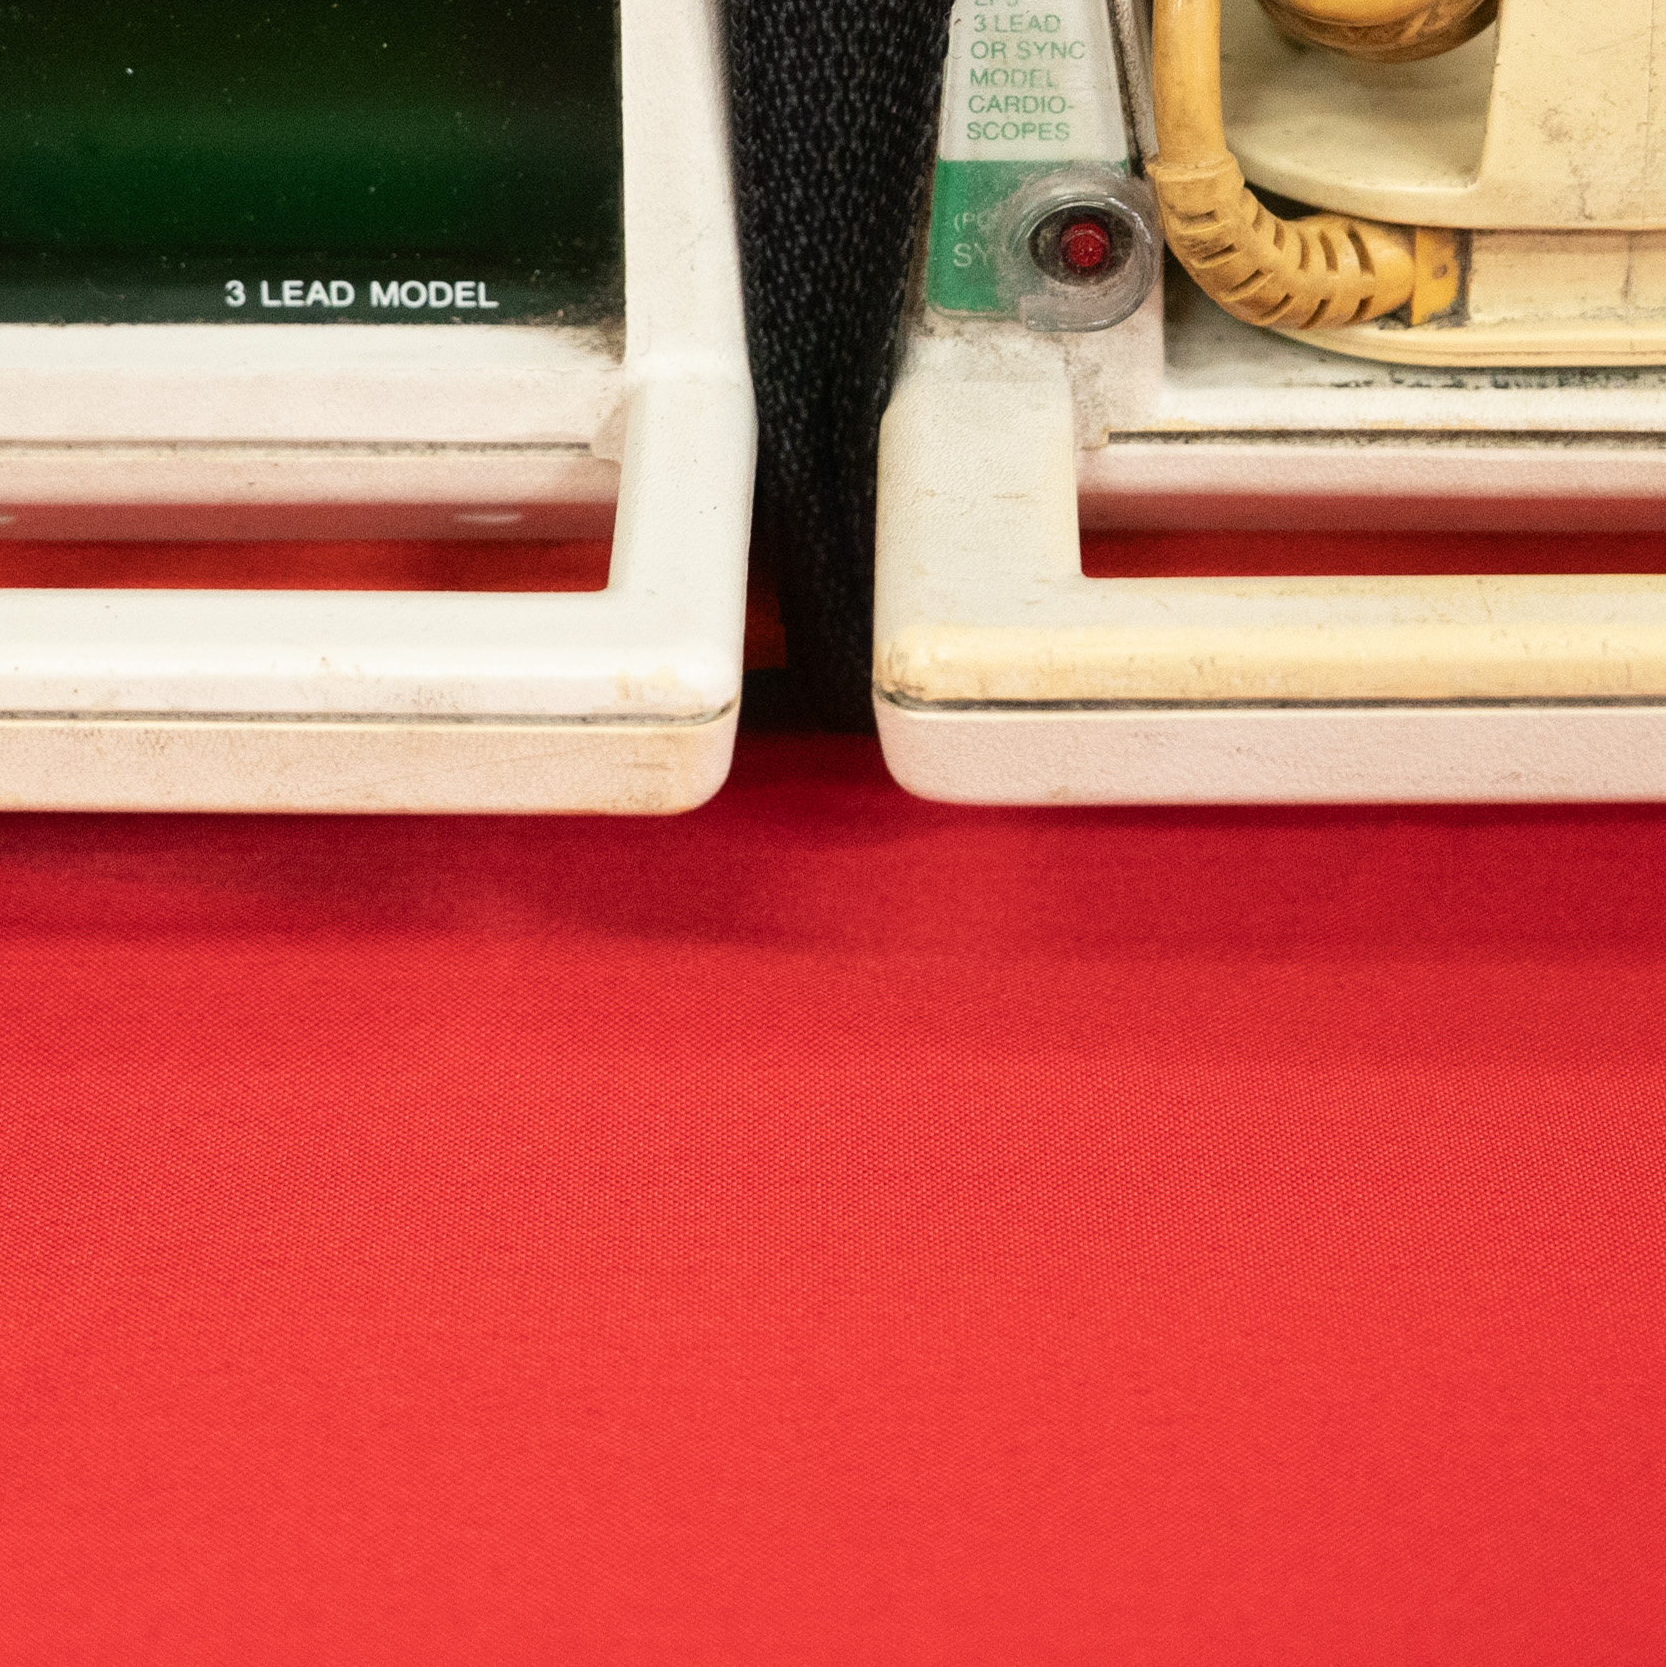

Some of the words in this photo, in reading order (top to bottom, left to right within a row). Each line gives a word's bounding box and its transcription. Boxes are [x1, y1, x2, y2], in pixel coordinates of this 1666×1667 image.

[973, 13, 987, 34] 3
[994, 13, 1062, 34] LEAD
[970, 40, 1007, 61] OR
[1015, 40, 1086, 61] SYNC
[969, 67, 1057, 89] MODEL
[968, 94, 1075, 115] CARDIO-
[966, 121, 1071, 142] SCOPES
[225, 280, 247, 308] 3
[260, 280, 356, 308] LEAD
[370, 280, 500, 309] MODEL
